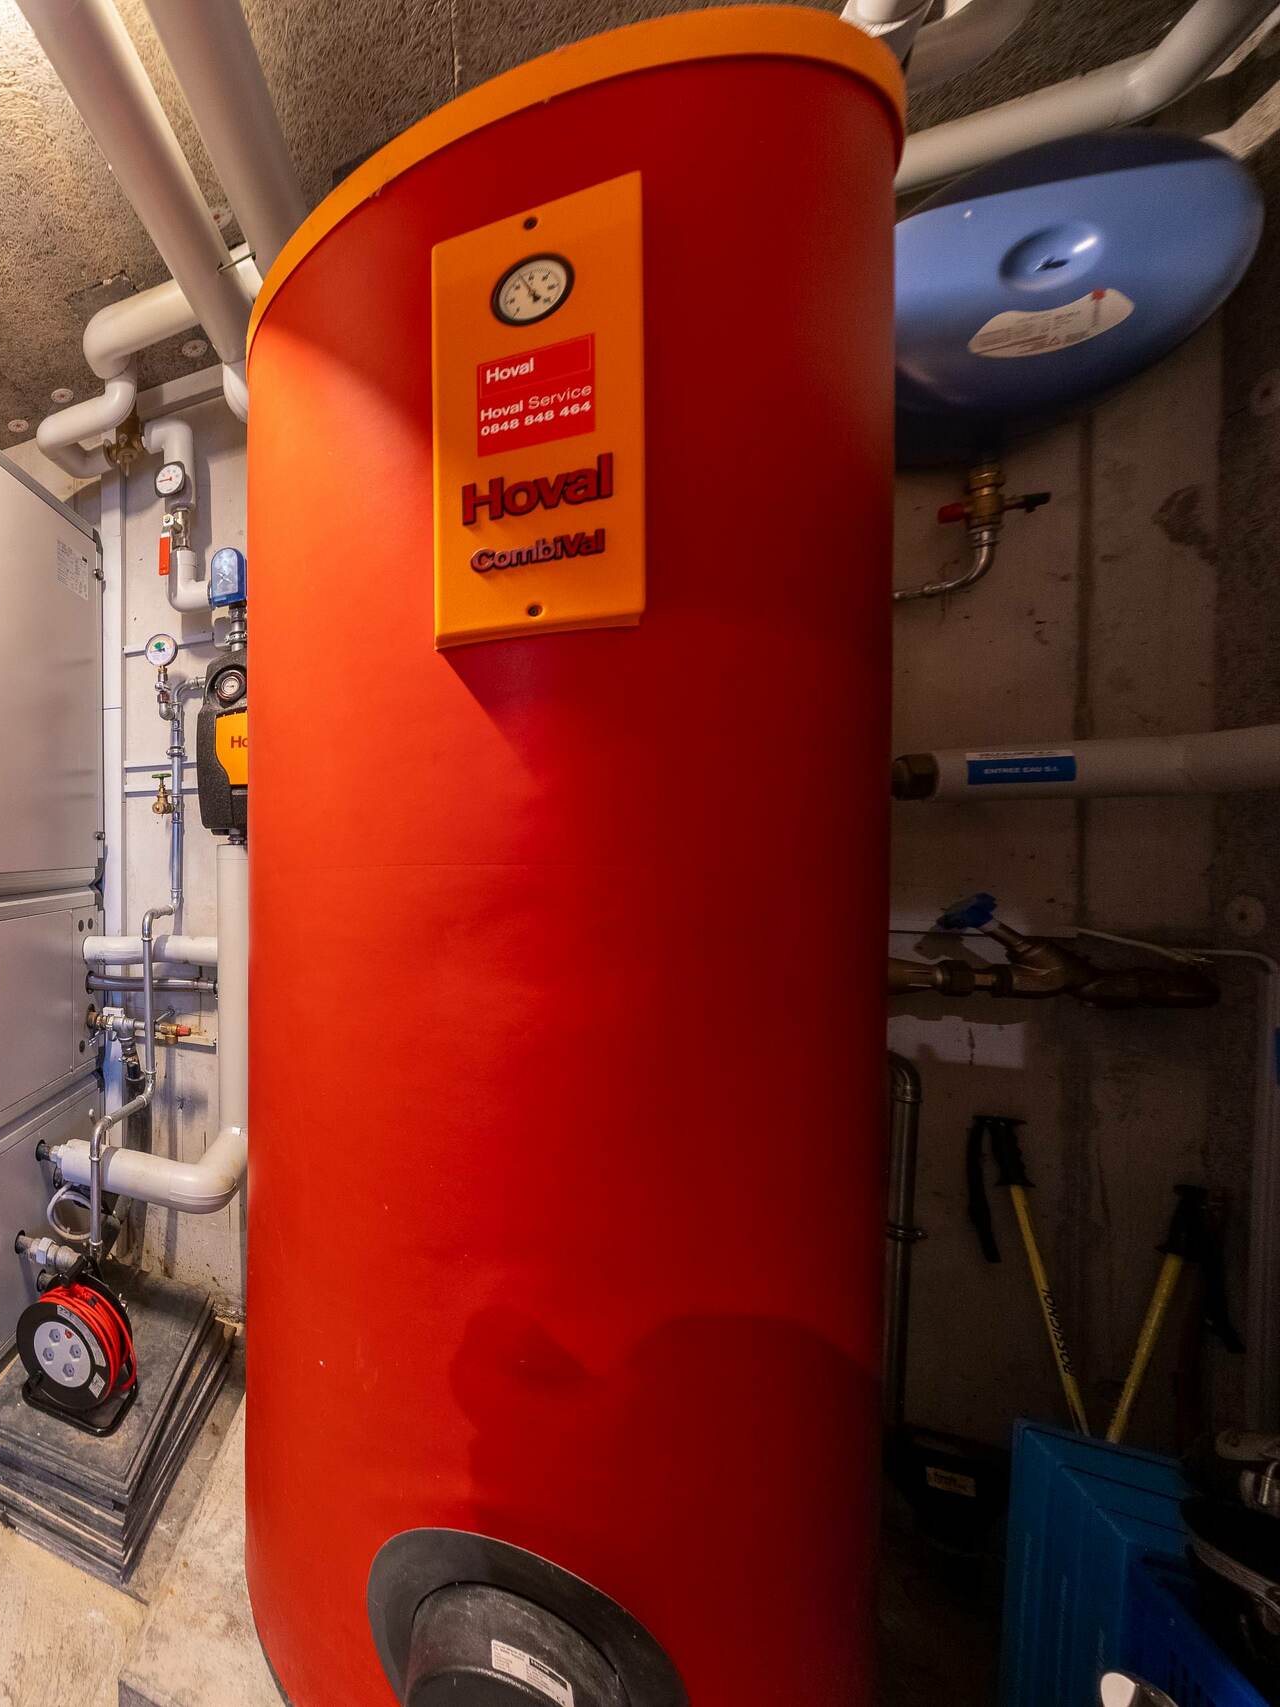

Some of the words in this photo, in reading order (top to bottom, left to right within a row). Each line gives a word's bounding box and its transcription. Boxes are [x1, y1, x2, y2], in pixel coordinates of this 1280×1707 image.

[485, 356, 535, 385] Hoval
[480, 400, 524, 422] Hoval
[527, 385, 593, 410] Service
[480, 417, 520, 437] 0848
[524, 410, 555, 426] 848
[559, 401, 592, 417] 464
[461, 451, 614, 527] Hoval
[470, 528, 607, 574] CombiVal
